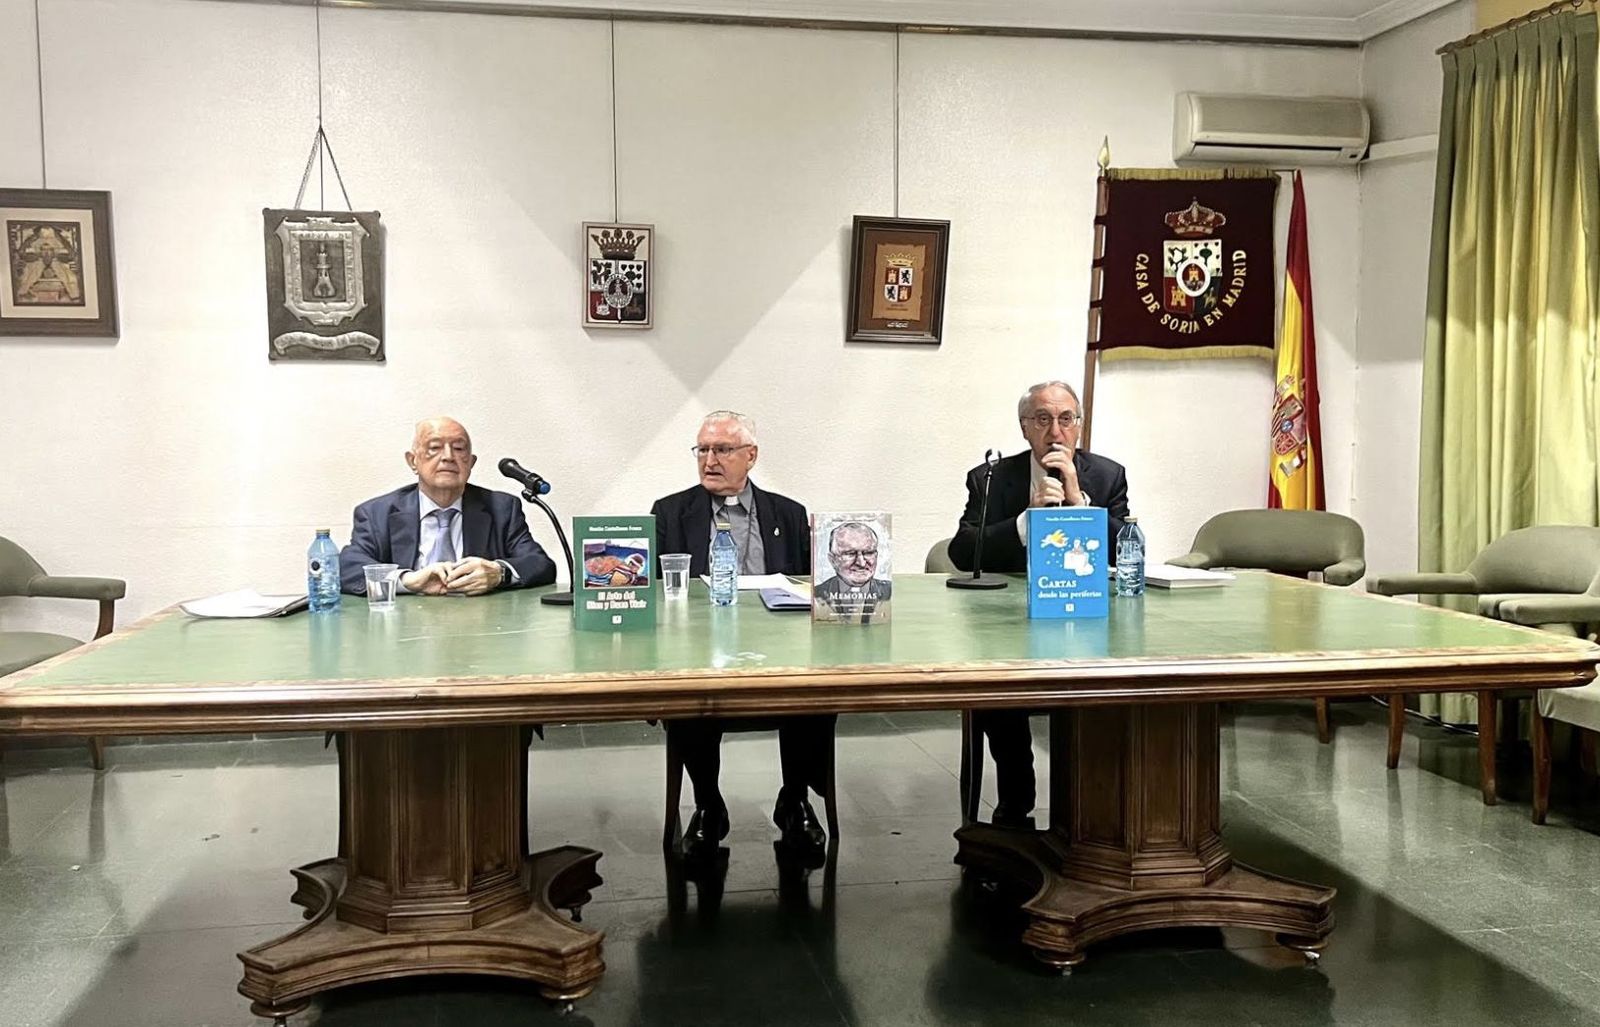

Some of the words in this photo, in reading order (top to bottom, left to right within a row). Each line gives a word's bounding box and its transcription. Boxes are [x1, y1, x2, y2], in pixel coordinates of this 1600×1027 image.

[1135, 252, 1150, 291] CASA
[1222, 249, 1248, 308] MADRID
[1141, 292, 1161, 314] DE
[1160, 313, 1200, 334] SORIA
[1203, 308, 1224, 327] EN
[1038, 576, 1077, 589] CARTAS
[829, 591, 878, 601] MEMORIAS
